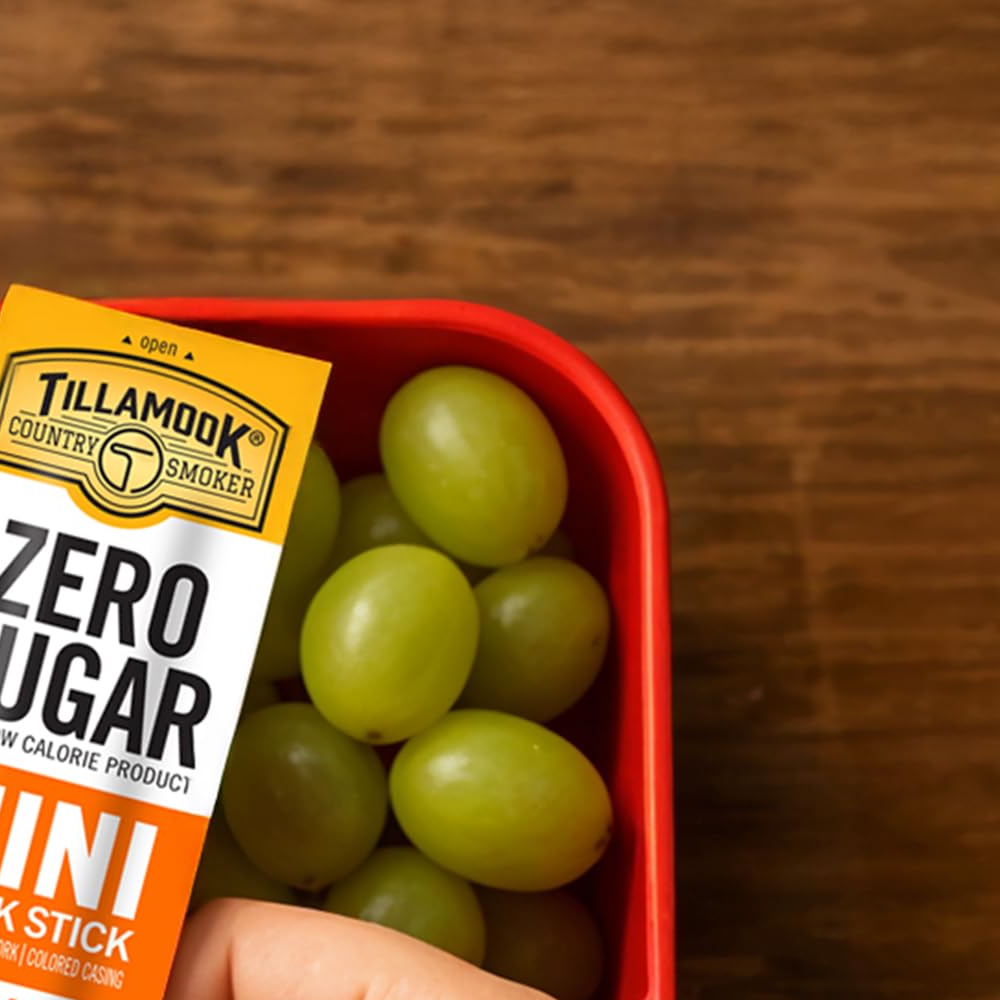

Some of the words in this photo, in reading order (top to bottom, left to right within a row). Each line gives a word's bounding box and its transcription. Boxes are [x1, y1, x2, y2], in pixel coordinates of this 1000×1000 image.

[140, 335, 178, 356] open
[8, 416, 100, 456] COUNTRY
[165, 457, 255, 498] SMOKER
[22, 735, 101, 771] CALORIE
[24, 906, 134, 962] STICK
[27, 947, 80, 978] COLORED
[81, 962, 125, 989] CASING
